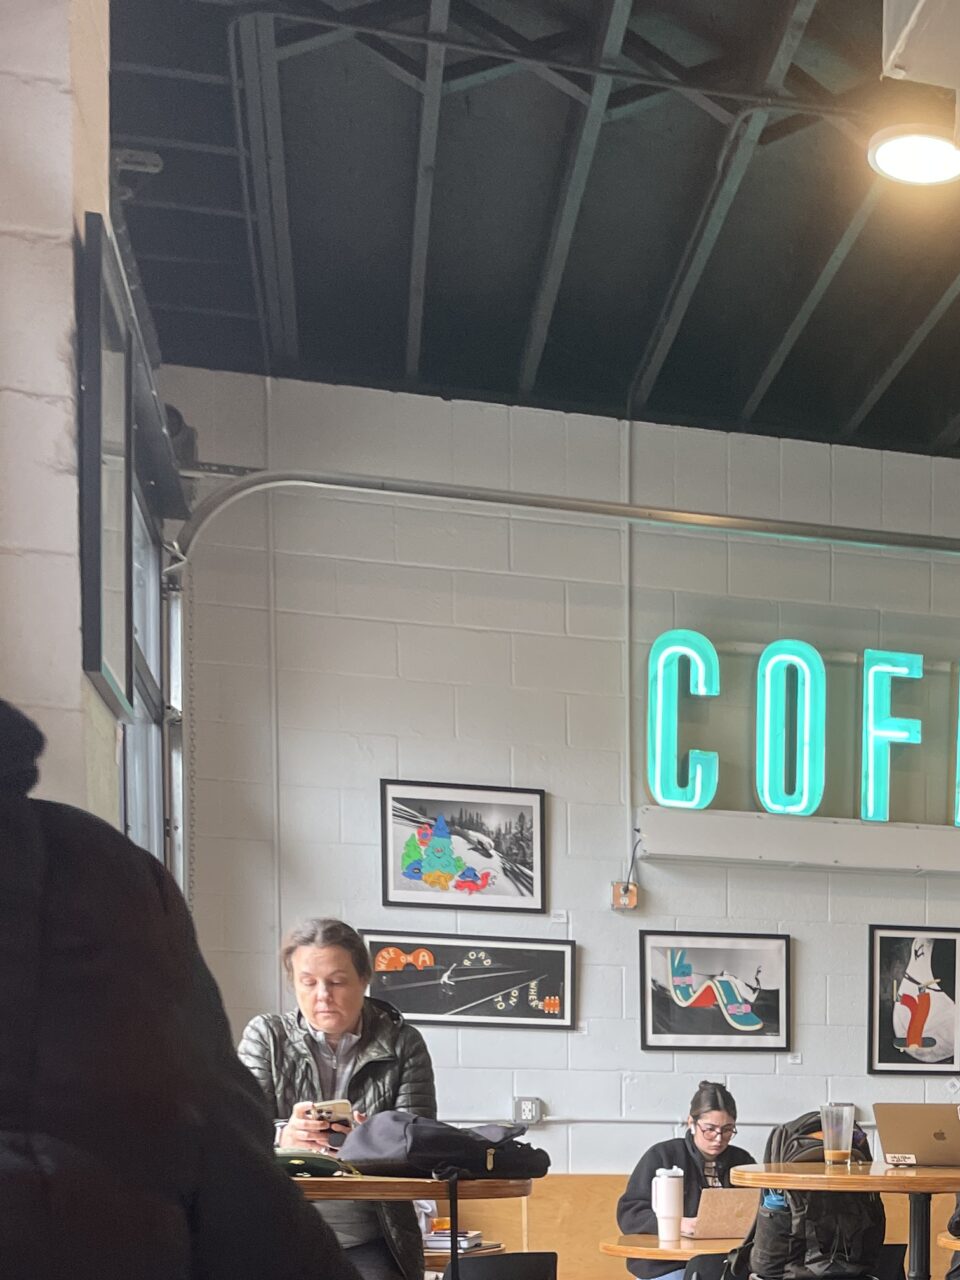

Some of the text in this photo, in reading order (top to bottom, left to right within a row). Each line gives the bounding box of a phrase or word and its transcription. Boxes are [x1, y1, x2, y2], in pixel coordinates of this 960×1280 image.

[418, 951, 430, 966] A
[463, 951, 491, 967] ROAD
[494, 995, 506, 1010] TO
